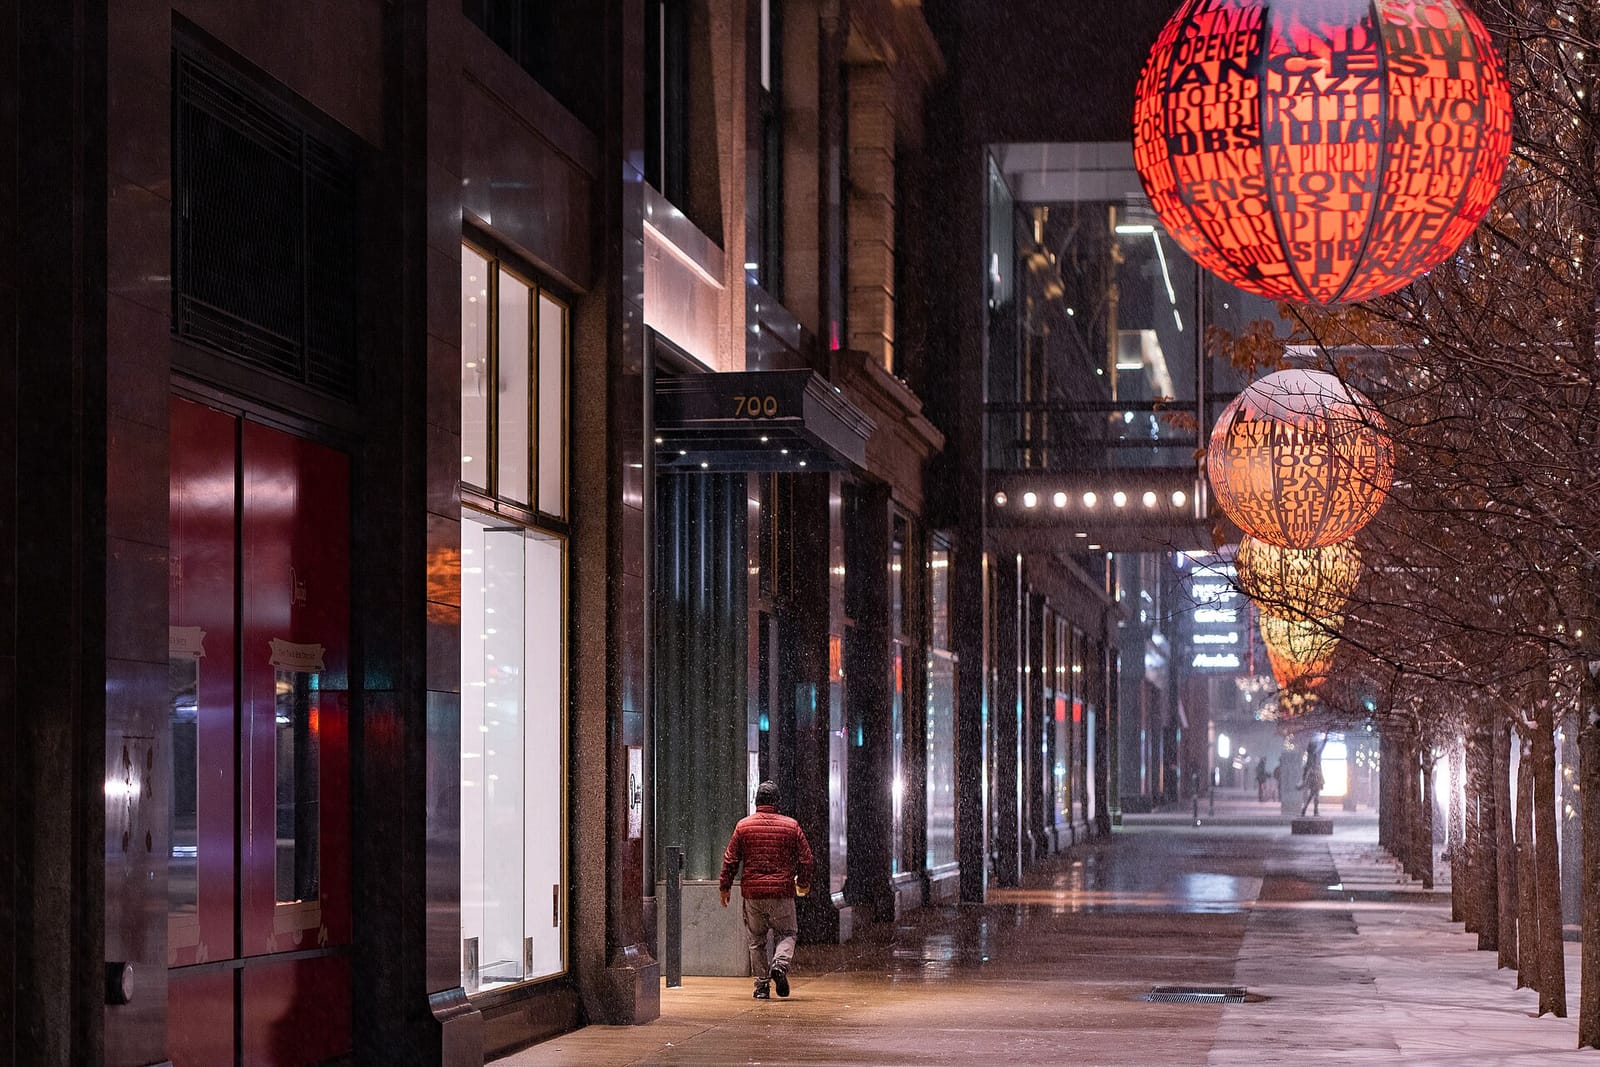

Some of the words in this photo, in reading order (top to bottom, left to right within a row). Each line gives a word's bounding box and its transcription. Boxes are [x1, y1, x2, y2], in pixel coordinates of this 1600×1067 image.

[1267, 74, 1377, 98] JAZZ
[1389, 77, 1477, 101] AFTER
[1300, 141, 1374, 174] PURPLE
[733, 396, 778, 417] 700
